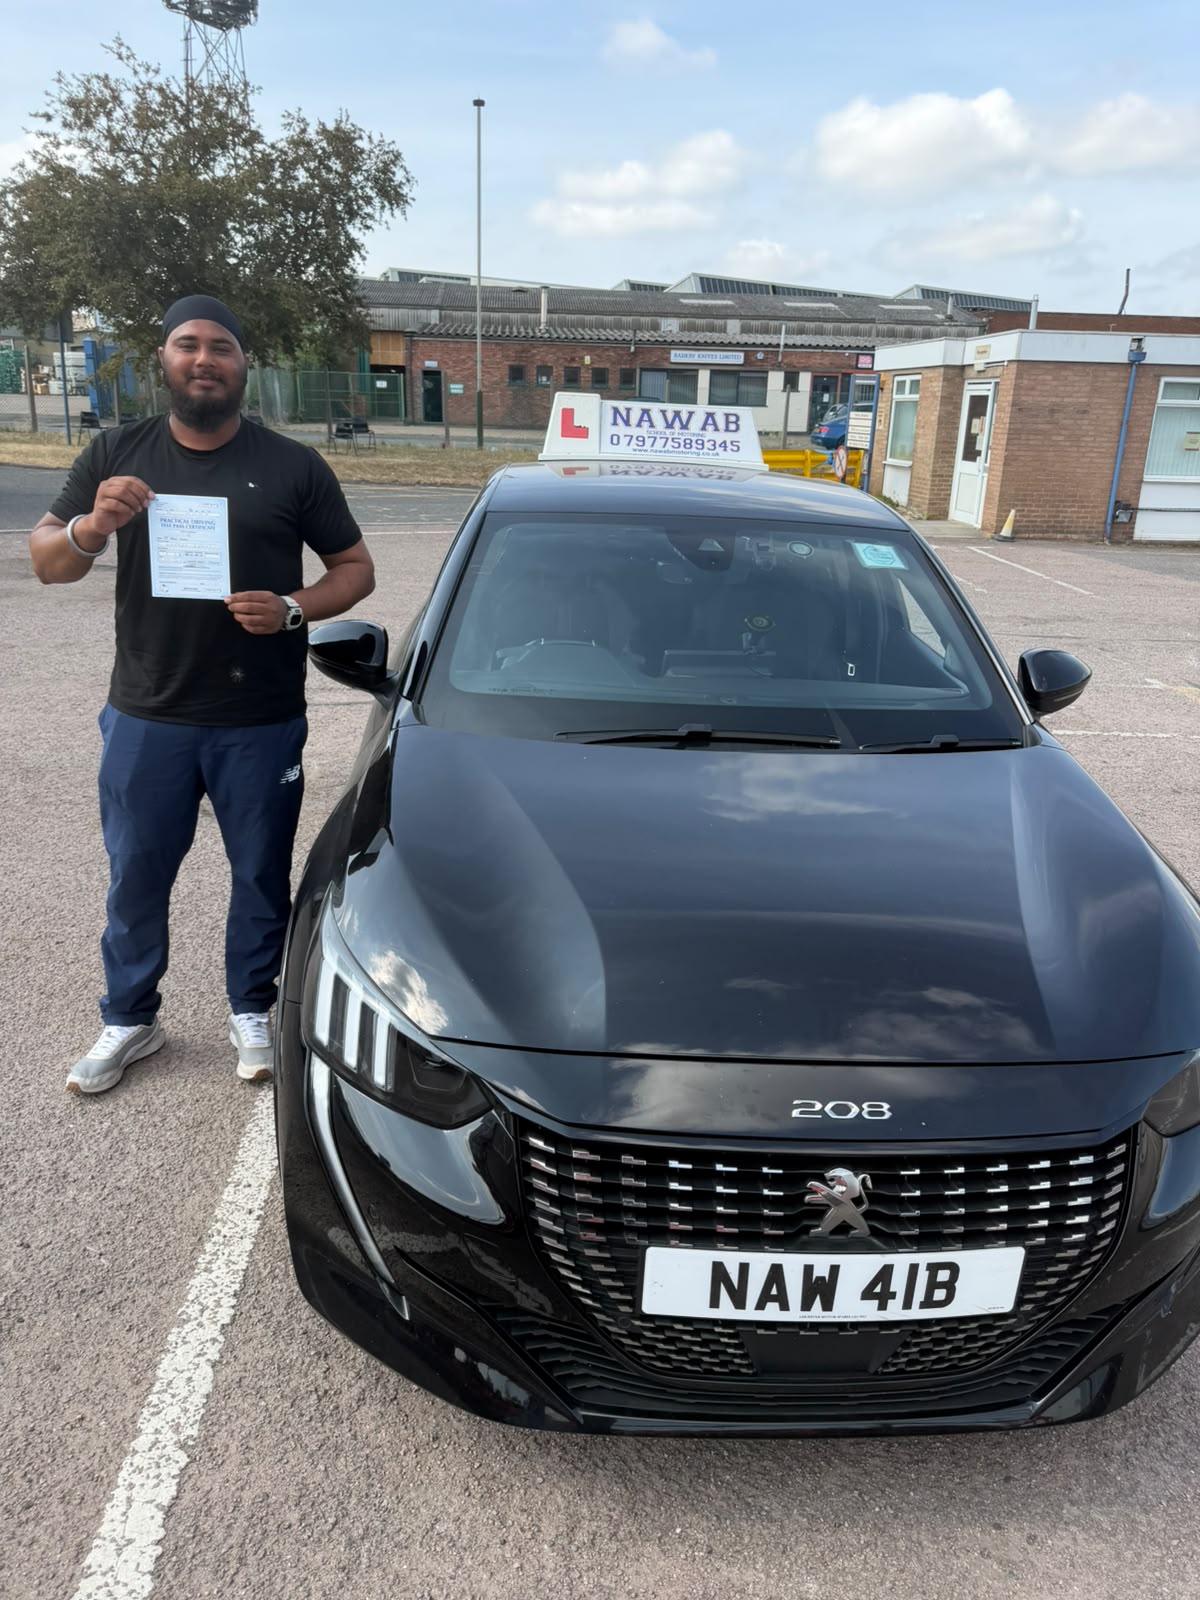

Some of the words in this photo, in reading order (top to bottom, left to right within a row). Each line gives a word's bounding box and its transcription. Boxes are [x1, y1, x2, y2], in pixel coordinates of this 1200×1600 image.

[561, 408, 589, 439] L
[611, 406, 741, 433] NAWAB
[632, 447, 720, 457] www.nawabmotoring.co.uk
[792, 1100, 892, 1119] 208
[709, 1261, 840, 1311] NAW
[860, 1261, 960, 1311] 41B
